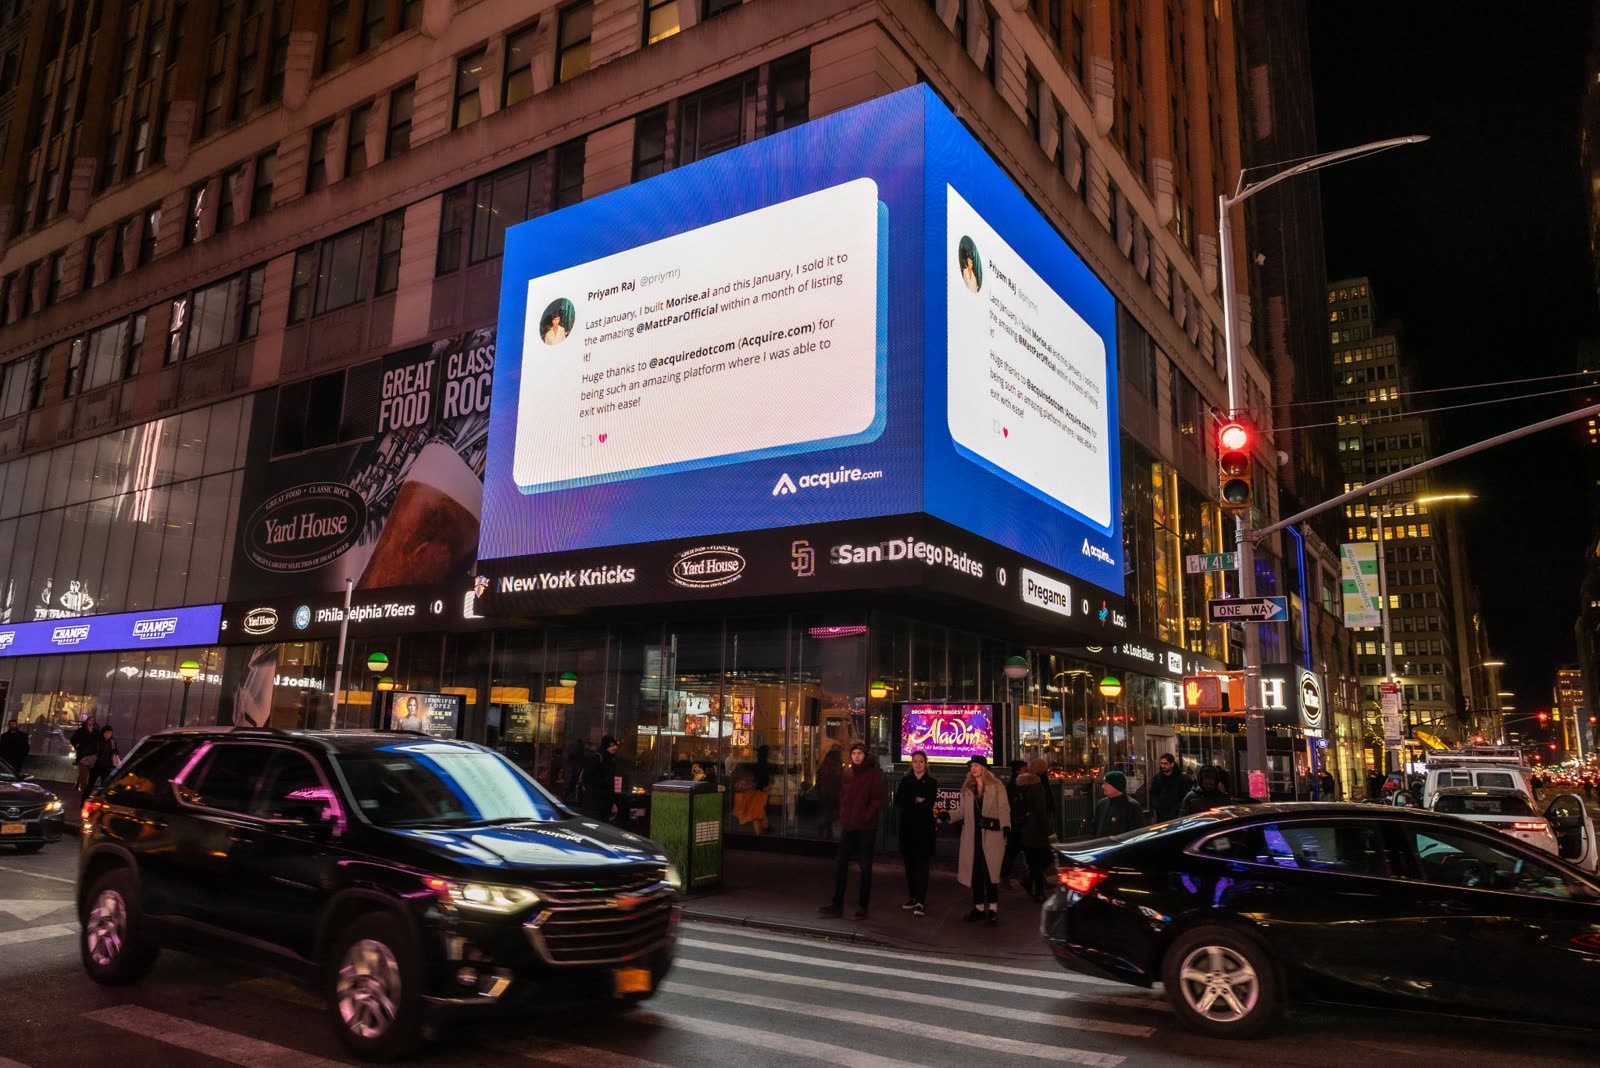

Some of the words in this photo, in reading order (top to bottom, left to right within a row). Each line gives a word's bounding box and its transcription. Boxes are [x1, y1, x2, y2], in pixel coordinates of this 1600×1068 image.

[587, 286, 616, 301] Priyam
[616, 278, 635, 293] Raj
[639, 268, 680, 286] @priymrj
[989, 259, 1006, 283] Priyam
[1006, 276, 1016, 295] Raj
[585, 318, 602, 329] Last
[602, 310, 637, 327] January,
[639, 306, 642, 315] I
[644, 301, 663, 314] built
[665, 287, 710, 308] Morise.ai
[712, 282, 730, 296] and
[732, 278, 750, 291] this
[751, 268, 793, 288] January,
[796, 264, 799, 274] I
[801, 257, 823, 273] sold
[826, 256, 834, 266] it
[836, 253, 848, 263] to
[584, 336, 597, 346] the
[599, 326, 634, 342] amazing
[636, 302, 718, 333] @MattParOfficial
[720, 296, 750, 311] within
[752, 295, 758, 304] a
[761, 284, 794, 301] month
[797, 279, 809, 292] of
[811, 273, 842, 289] listing
[581, 371, 604, 383] Huge
[606, 364, 635, 378] thanks
[637, 361, 647, 371] to
[648, 341, 735, 368] @acquiredotcom
[737, 321, 815, 350] (Acquire.com)
[818, 318, 835, 330] for
[583, 352, 591, 362] it!
[382, 360, 436, 400] GREAT
[580, 388, 604, 400] being
[606, 382, 626, 395] such
[628, 380, 640, 390] an
[641, 371, 681, 387] amazing
[683, 362, 725, 381] platform
[727, 354, 760, 369] where
[763, 351, 766, 361] I
[768, 348, 790, 360] was
[792, 341, 816, 355] able
[819, 339, 831, 349] to
[378, 390, 430, 433] FOOD
[579, 407, 595, 417] exit
[596, 401, 615, 414] with
[617, 396, 640, 410] ease!
[799, 466, 882, 490] acquire.com
[265, 496, 285, 510] GREAT
[285, 488, 302, 500] FOOD
[308, 485, 333, 494] CLASSIC
[332, 486, 351, 498] ROCK
[264, 514, 296, 545] Yard
[298, 512, 348, 541] House
[312, 558, 320, 566] OF
[320, 550, 336, 564] DRAFT
[336, 542, 350, 556] BEER
[681, 559, 705, 576] Yard
[706, 558, 739, 574] House
[838, 544, 881, 564] San
[888, 536, 942, 566] Diego
[944, 546, 984, 578] Padres
[998, 567, 1006, 586] 0
[1200, 557, 1208, 570] W
[1212, 556, 1223, 569] 41
[1226, 555, 1234, 564] St
[502, 576, 537, 593] New
[540, 570, 576, 590] York
[579, 564, 636, 586] Knicks
[1346, 549, 1371, 608] #GarmentDistrict
[1028, 578, 1067, 608] Pregame
[248, 617, 259, 626] Yard
[259, 616, 275, 626] House
[384, 603, 416, 618] 76ers
[434, 600, 443, 614] 0
[1083, 599, 1089, 615] 0
[1113, 610, 1124, 628] Los
[1220, 606, 1241, 616] ONE
[1251, 604, 1274, 614] WAY
[54, 628, 88, 639] CHAMPS
[135, 620, 176, 634] CHAMPS
[1130, 644, 1142, 658] Louis
[1142, 648, 1154, 662] Blues
[1159, 654, 1163, 664] 2
[1170, 656, 1180, 669] Final
[912, 718, 980, 744] Aladdin
